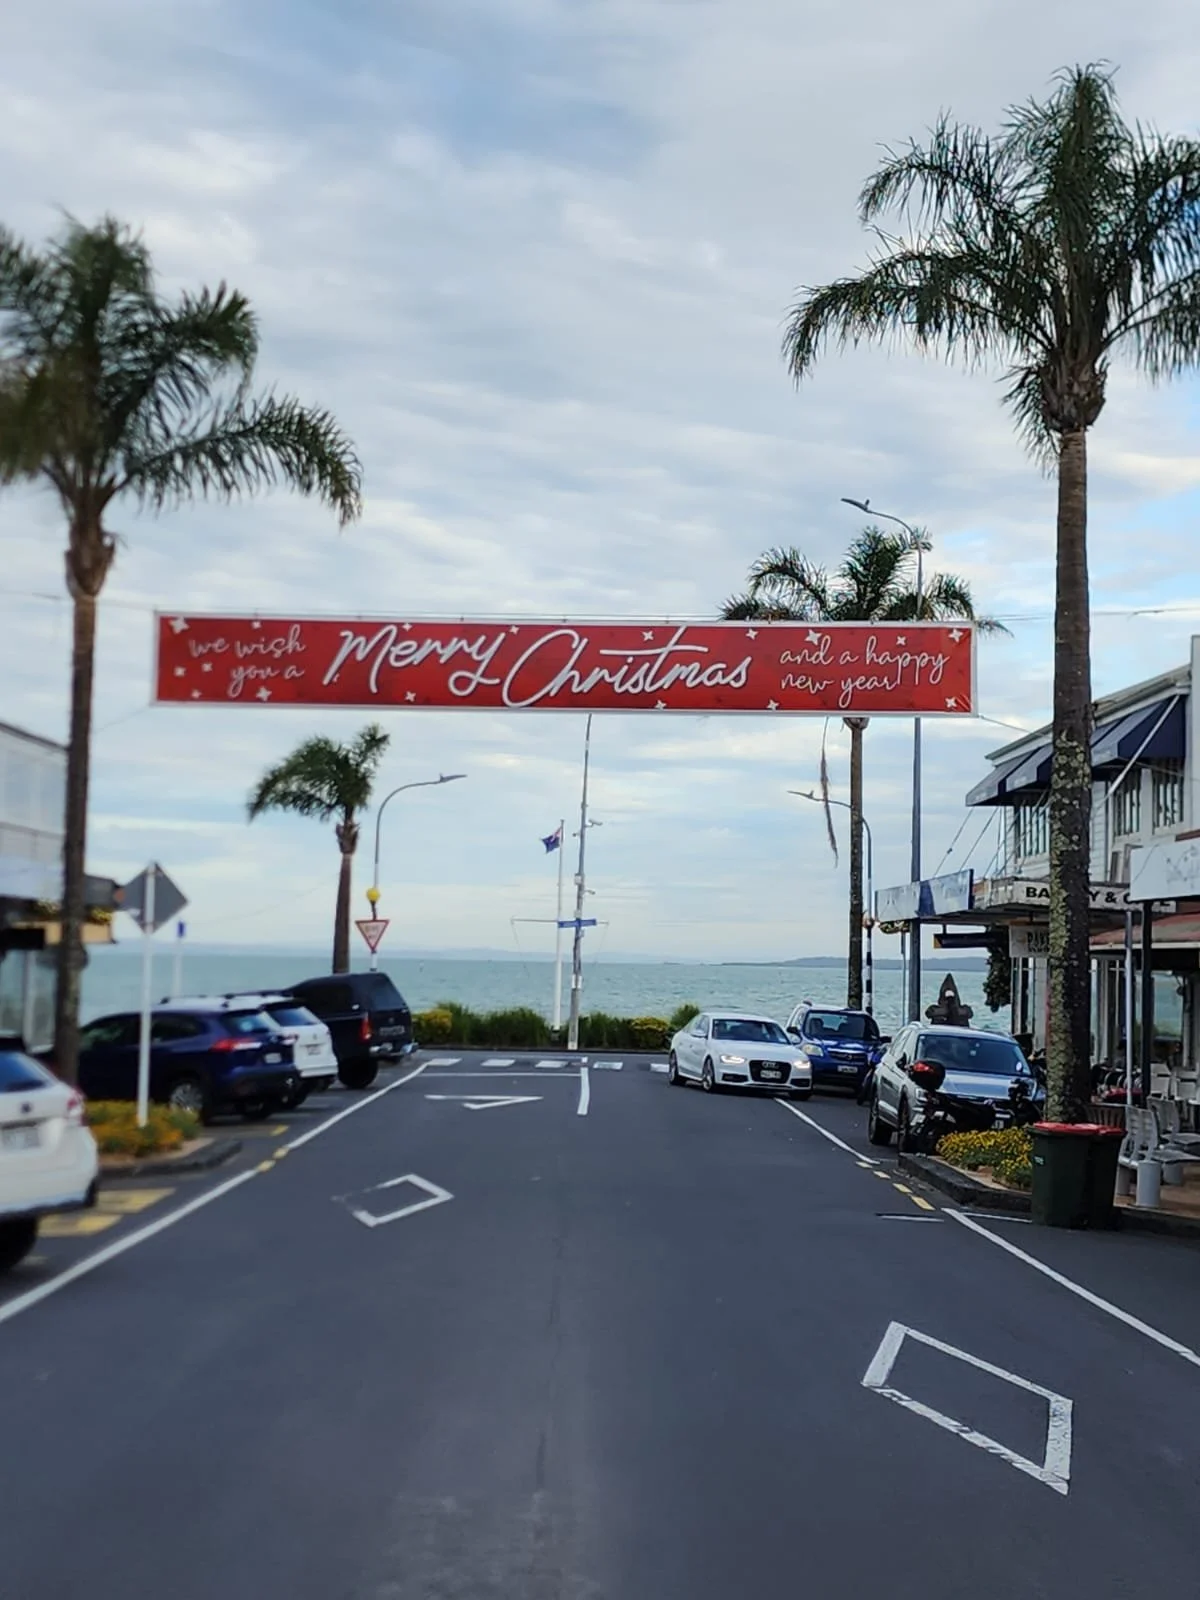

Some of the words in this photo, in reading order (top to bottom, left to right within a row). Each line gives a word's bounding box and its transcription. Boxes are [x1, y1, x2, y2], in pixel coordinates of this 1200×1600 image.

[188, 638, 230, 658] we
[234, 623, 306, 659] wish
[322, 624, 507, 697] Merry
[501, 625, 753, 708] Christmas
[779, 635, 834, 665] and
[839, 649, 860, 665] a
[865, 635, 951, 685] happy
[227, 665, 281, 698] you
[284, 664, 306, 680] a
[781, 673, 835, 694] new
[838, 675, 897, 709] year
[1026, 886, 1100, 903] BAY
[1105, 890, 1118, 904] &
